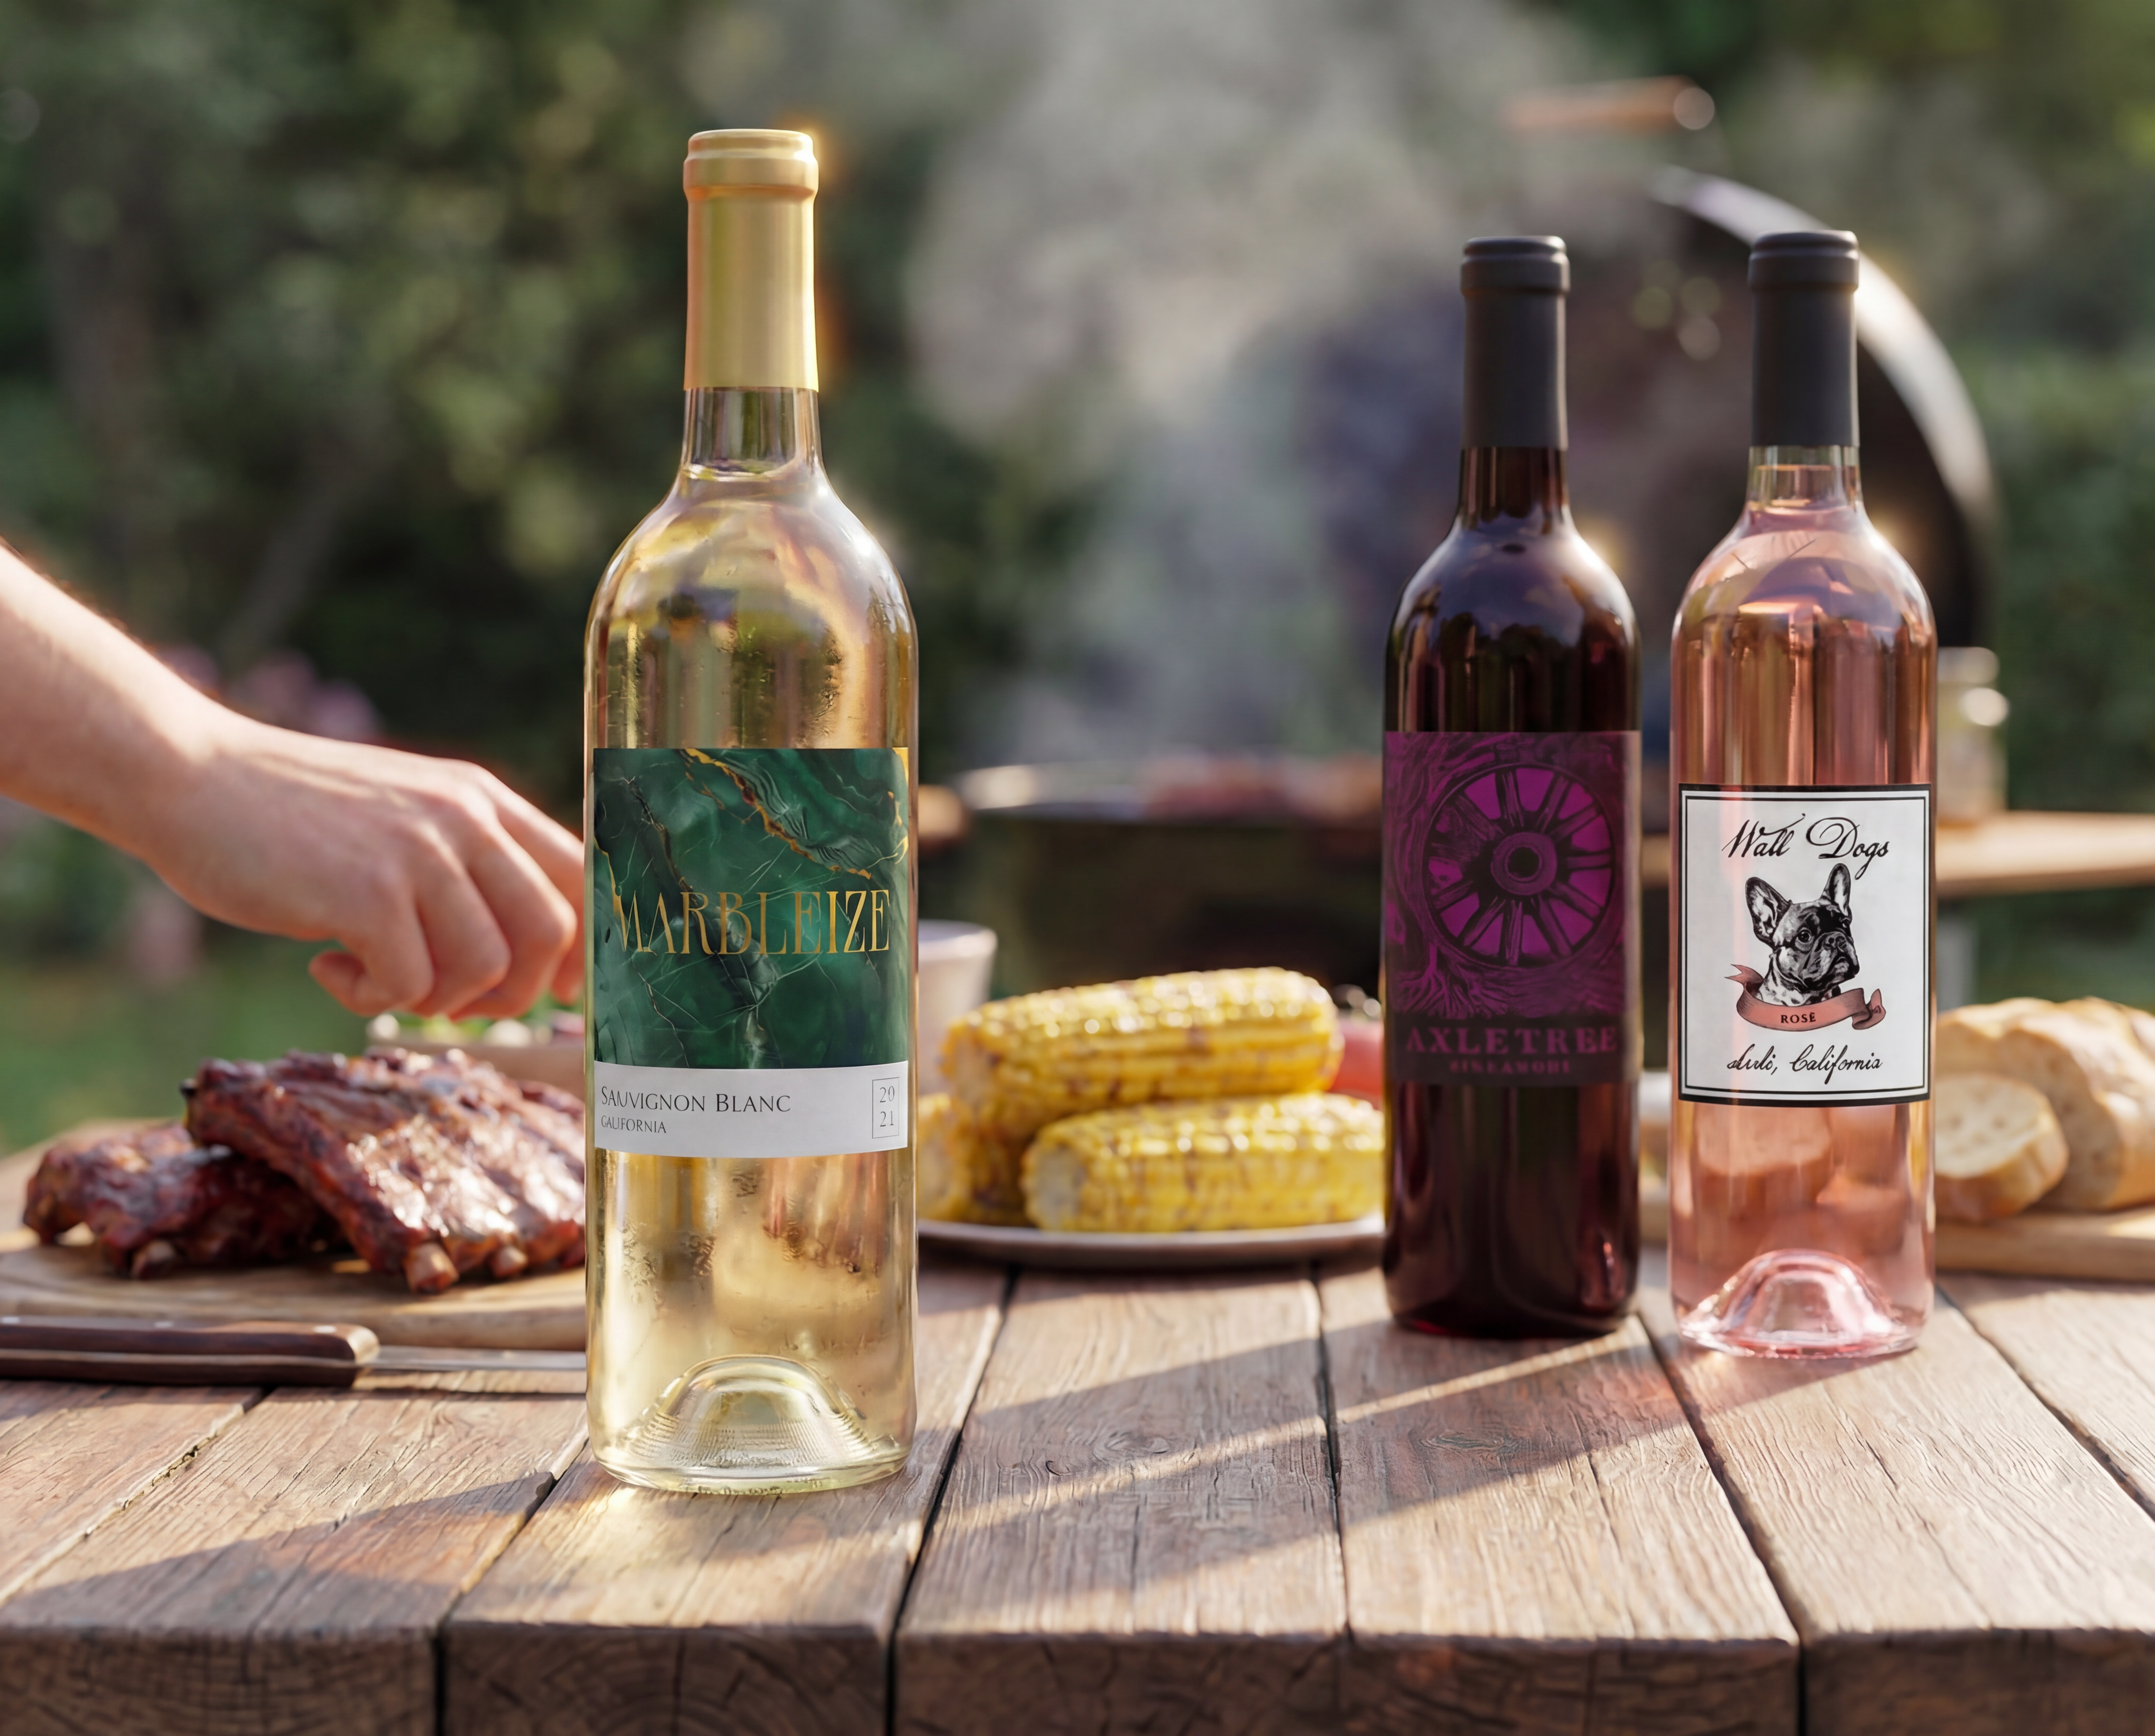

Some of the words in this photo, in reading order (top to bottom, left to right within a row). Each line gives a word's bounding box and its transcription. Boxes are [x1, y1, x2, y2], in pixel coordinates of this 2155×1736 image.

[1721, 813, 1806, 858] Wall
[1806, 817, 1890, 880] Dogs
[613, 889, 889, 955] MARBLEIZE
[1406, 1026, 1617, 1055] AXLETREE
[1789, 1043, 1883, 1085] California
[880, 1085, 895, 1103] 20
[601, 1115, 666, 1134] CALIFORNIA
[880, 1110, 894, 1127] 21
